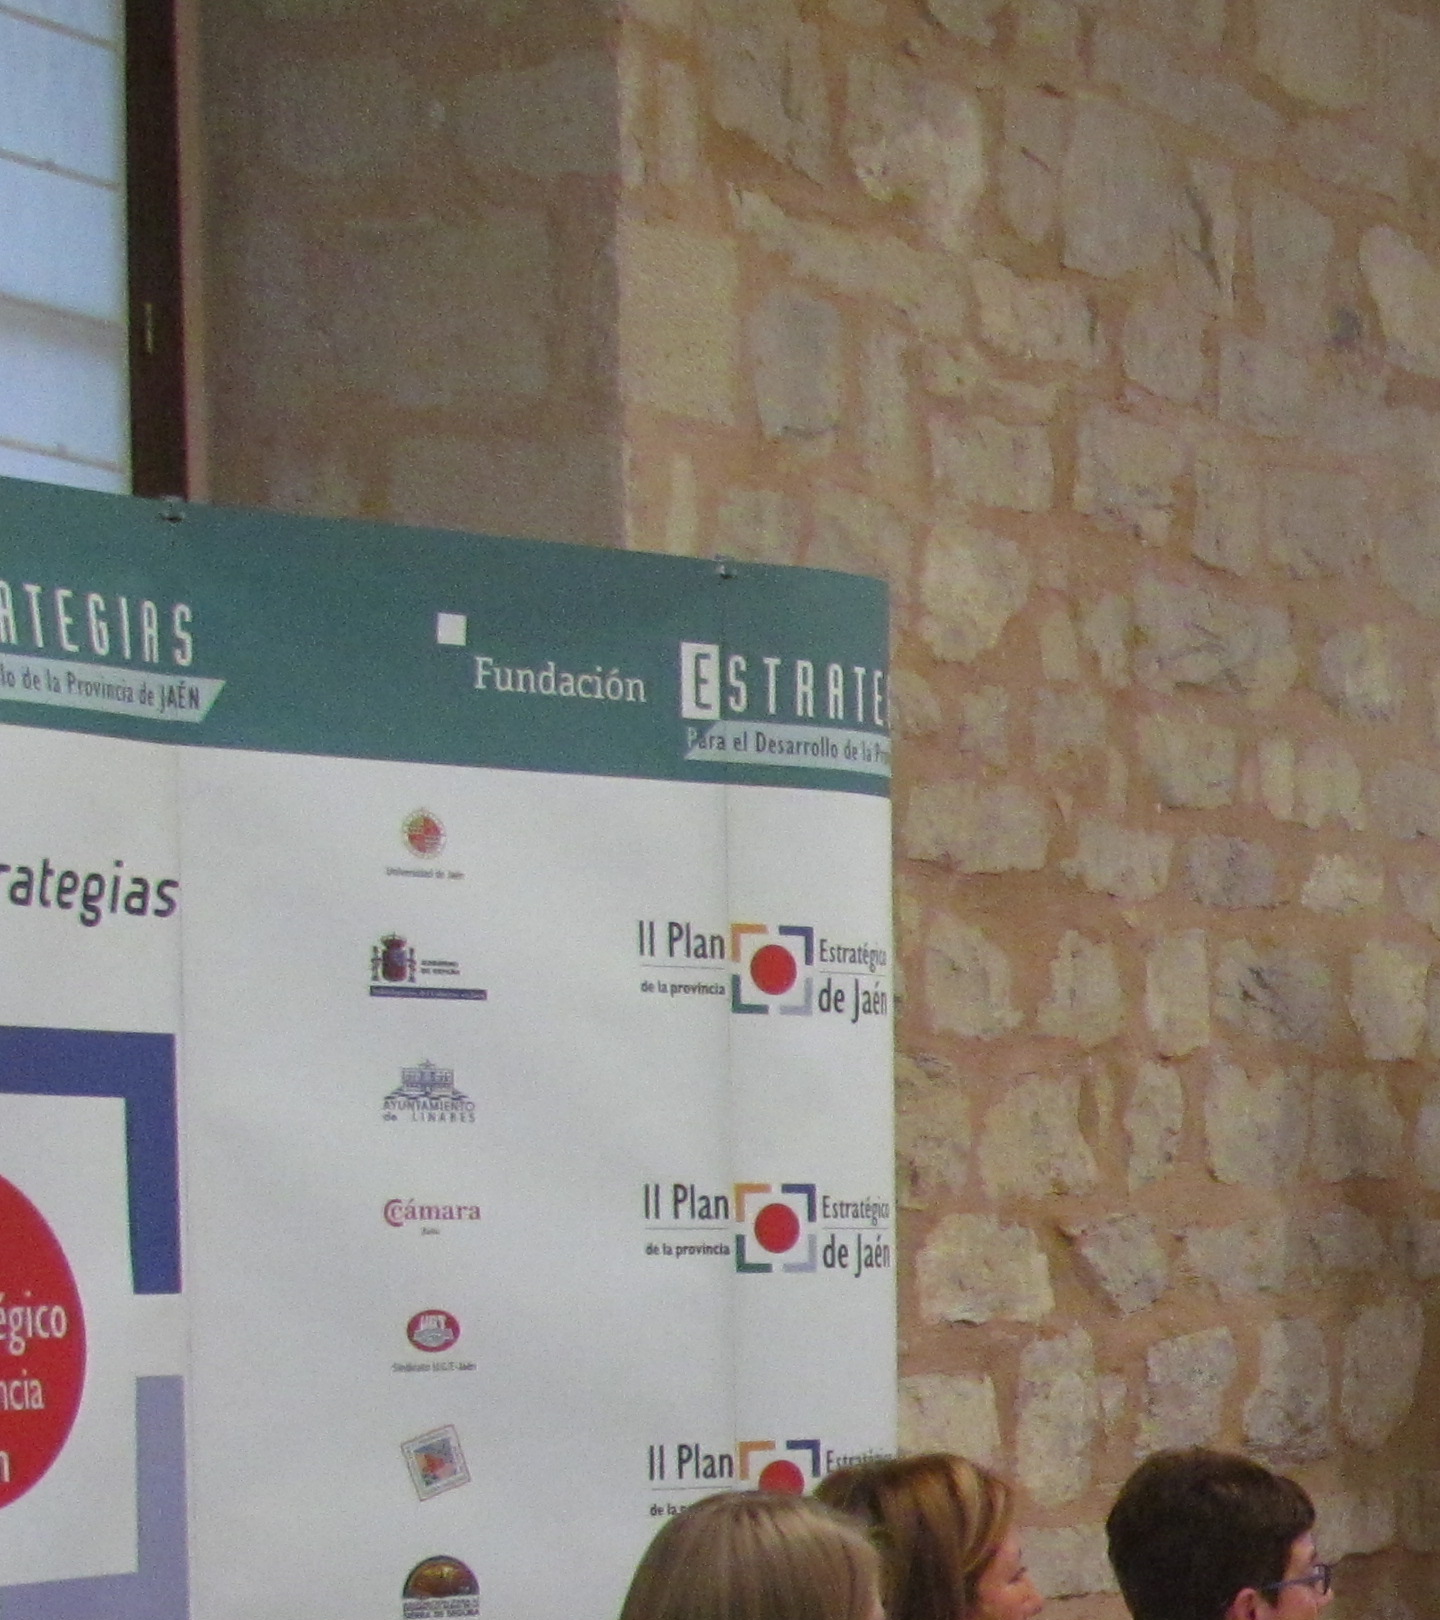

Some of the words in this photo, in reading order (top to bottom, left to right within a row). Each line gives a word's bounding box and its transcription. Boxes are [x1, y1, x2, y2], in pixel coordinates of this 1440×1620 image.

[22, 667, 41, 691] de
[47, 669, 61, 694] la
[67, 671, 134, 704] Provincia
[140, 682, 155, 707] de
[159, 680, 200, 714] JAÉN
[474, 655, 648, 703] Fundación
[692, 650, 888, 727] ESTRATE
[687, 726, 725, 750] Para
[733, 731, 748, 752] el
[756, 732, 839, 759] Desarrollo
[668, 921, 726, 960] Plan
[641, 980, 655, 993] de
[658, 980, 668, 994] la
[671, 981, 726, 998] provincia
[818, 977, 846, 1014] de
[850, 978, 888, 1025] Jaén
[673, 1182, 730, 1220] Plan
[822, 1195, 891, 1227] Estratégico
[645, 1243, 659, 1256] de
[663, 1243, 673, 1256] la
[676, 1242, 731, 1260] provincia
[822, 1234, 850, 1269] de
[853, 1234, 891, 1279] Jaén
[677, 1442, 734, 1480] Plan
